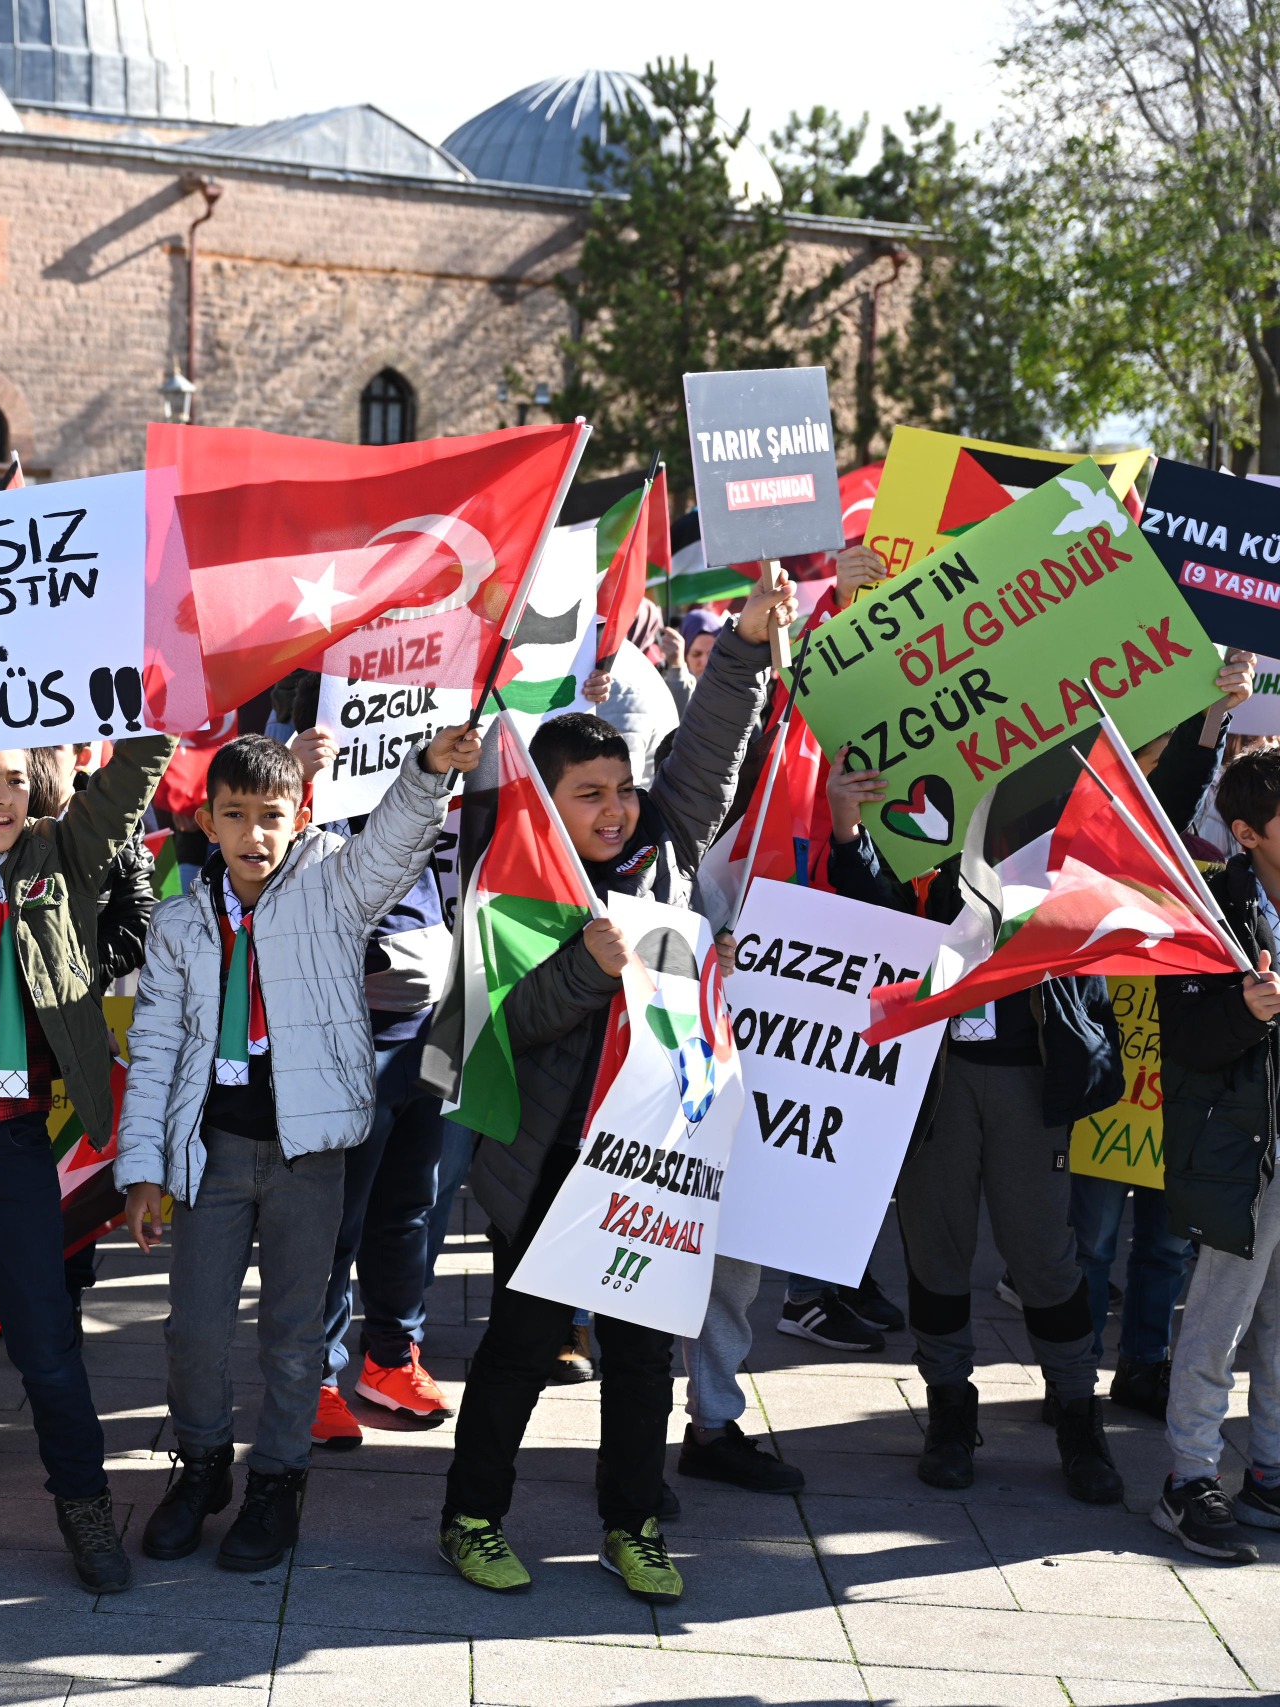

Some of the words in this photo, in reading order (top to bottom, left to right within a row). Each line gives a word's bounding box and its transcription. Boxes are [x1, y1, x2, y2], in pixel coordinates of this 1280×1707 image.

[697, 428, 764, 463] TARIK
[766, 417, 830, 463] ŞAHİN
[728, 481, 750, 506] (11
[752, 475, 814, 504] YAŞINDA)
[1140, 507, 1228, 552] ZYNA
[1183, 562, 1206, 584] (9
[787, 551, 980, 697] FİLİSTİN
[894, 525, 1133, 687] ÖZGÜRDÜR
[347, 630, 444, 687] DENİZE
[340, 679, 439, 729] ÖZGÜR
[840, 667, 1010, 773] ÖZGÜR
[956, 616, 1193, 782] KALACAK
[726, 1002, 902, 1087] OYKIRIM
[752, 1090, 844, 1164] VAR
[598, 1191, 705, 1255] YAŞAMALI
